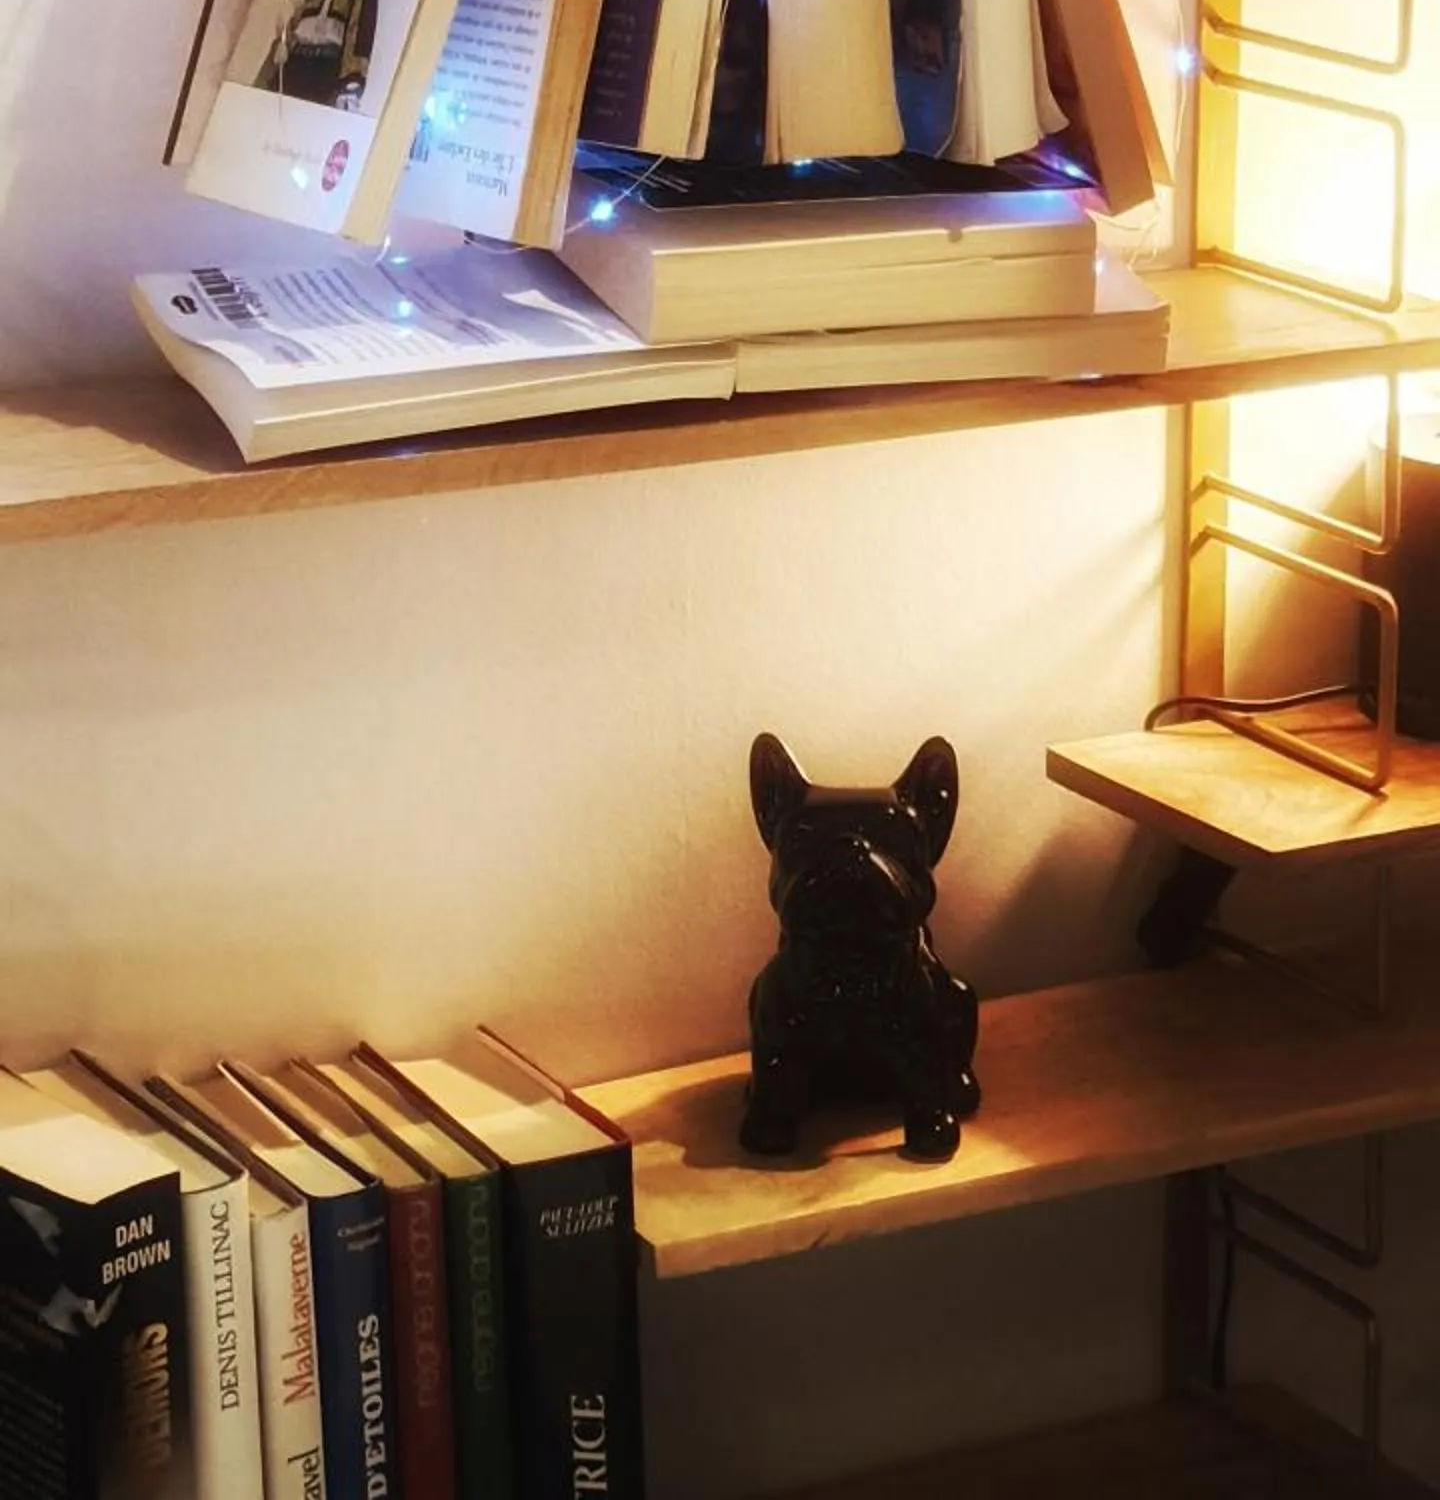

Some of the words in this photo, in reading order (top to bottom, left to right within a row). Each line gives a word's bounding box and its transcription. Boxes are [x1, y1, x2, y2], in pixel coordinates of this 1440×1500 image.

[102, 1240, 171, 1285] BROWN
[115, 1214, 154, 1248] DAN
[210, 1200, 236, 1327] TILLINAC
[282, 1232, 316, 1406] Malataverne
[217, 1329, 240, 1412] DENIS
